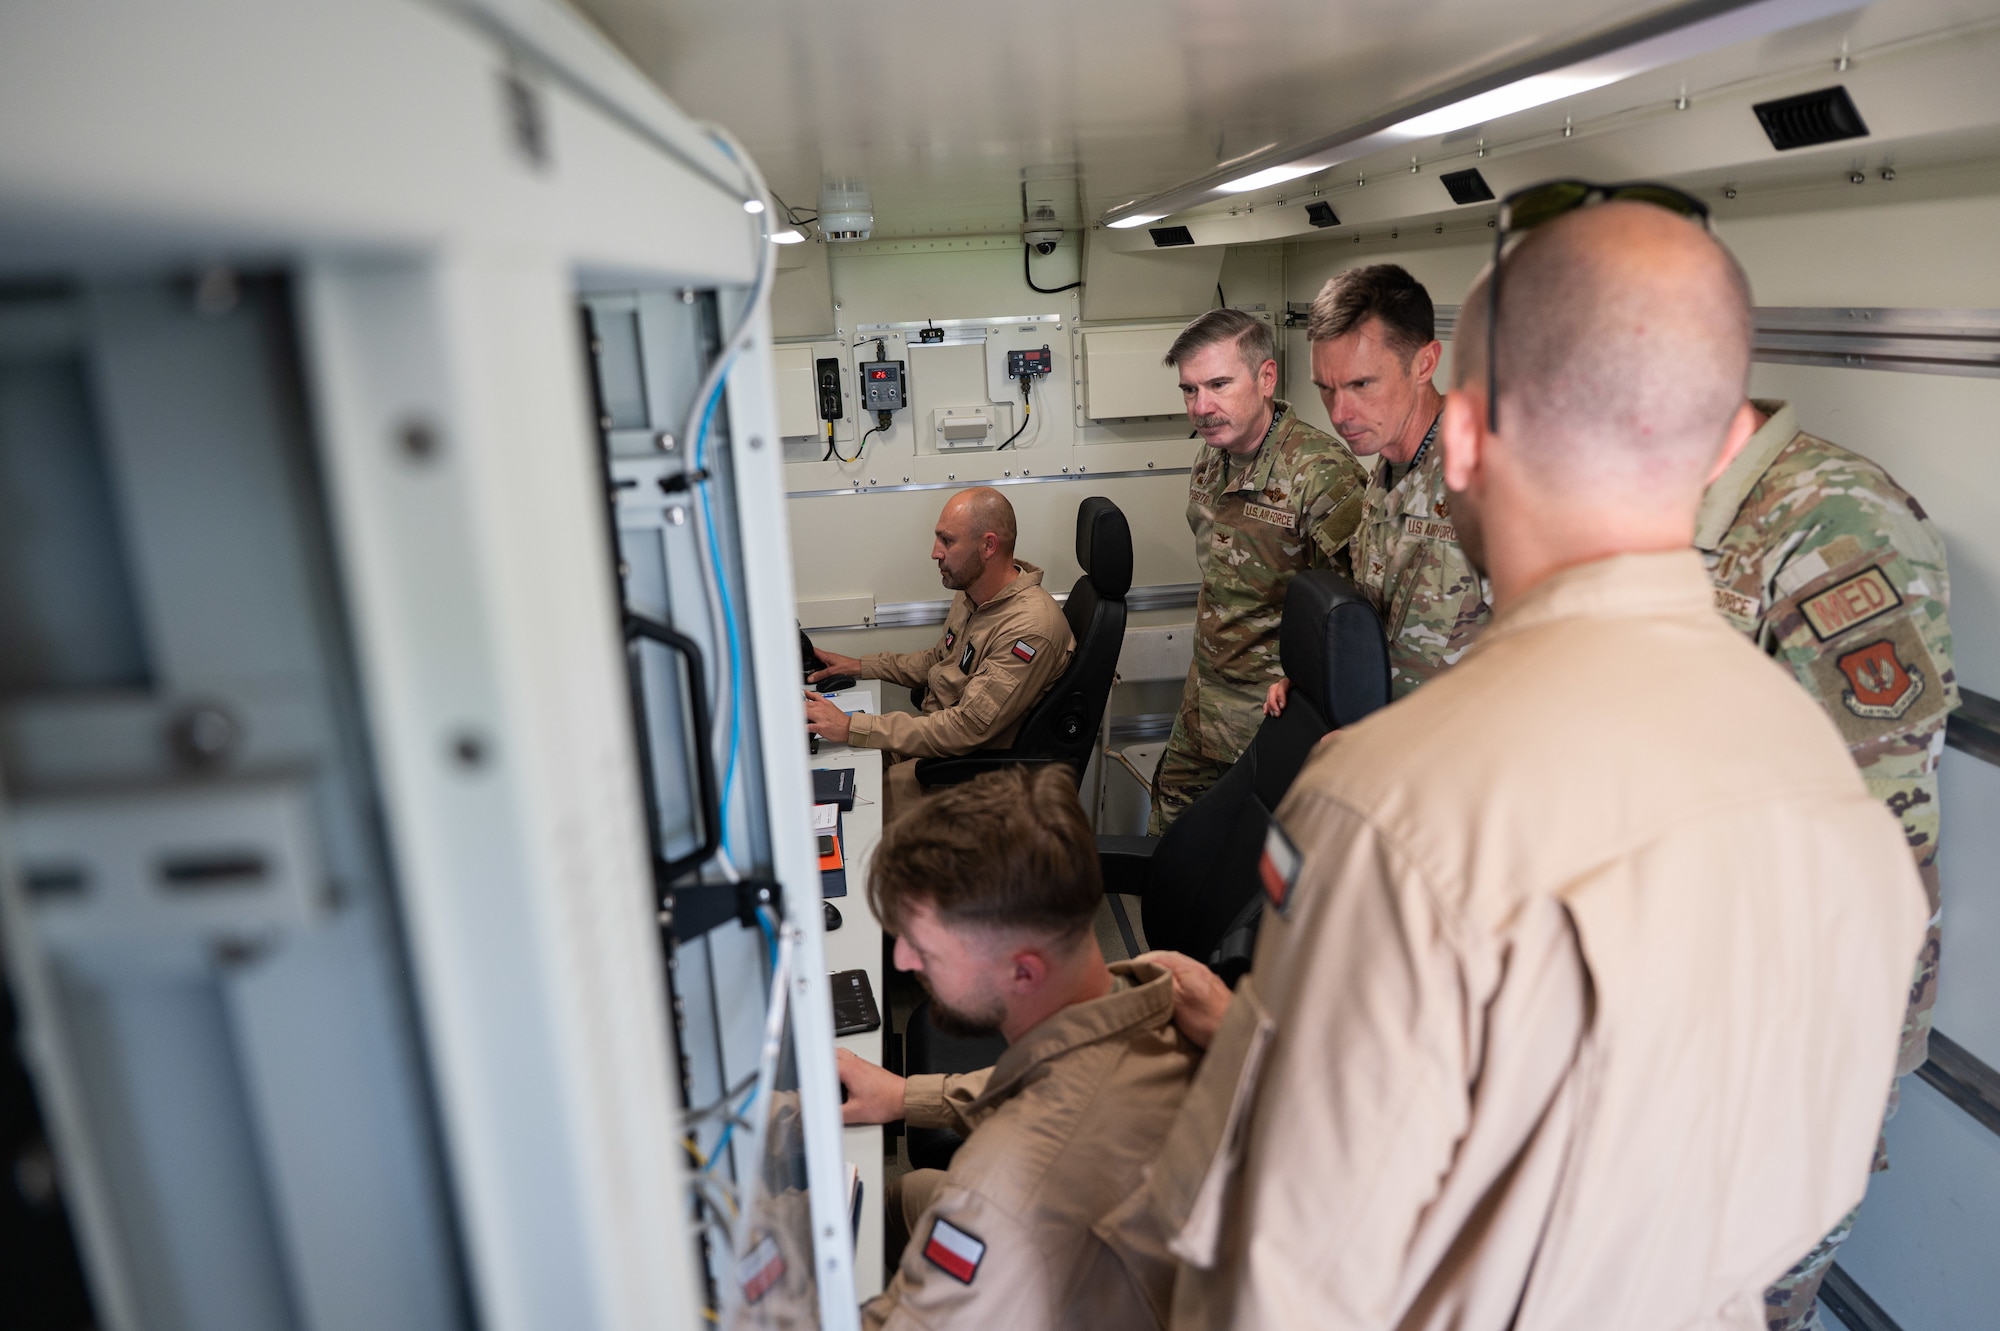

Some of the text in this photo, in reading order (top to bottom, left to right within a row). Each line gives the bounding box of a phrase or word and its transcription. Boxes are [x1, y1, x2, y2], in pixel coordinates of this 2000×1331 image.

[1245, 504, 1293, 526] U.S. AIR FORCE
[1424, 522, 1438, 537] AIR
[1435, 525, 1457, 540] FORC
[1812, 577, 1886, 632] MED
